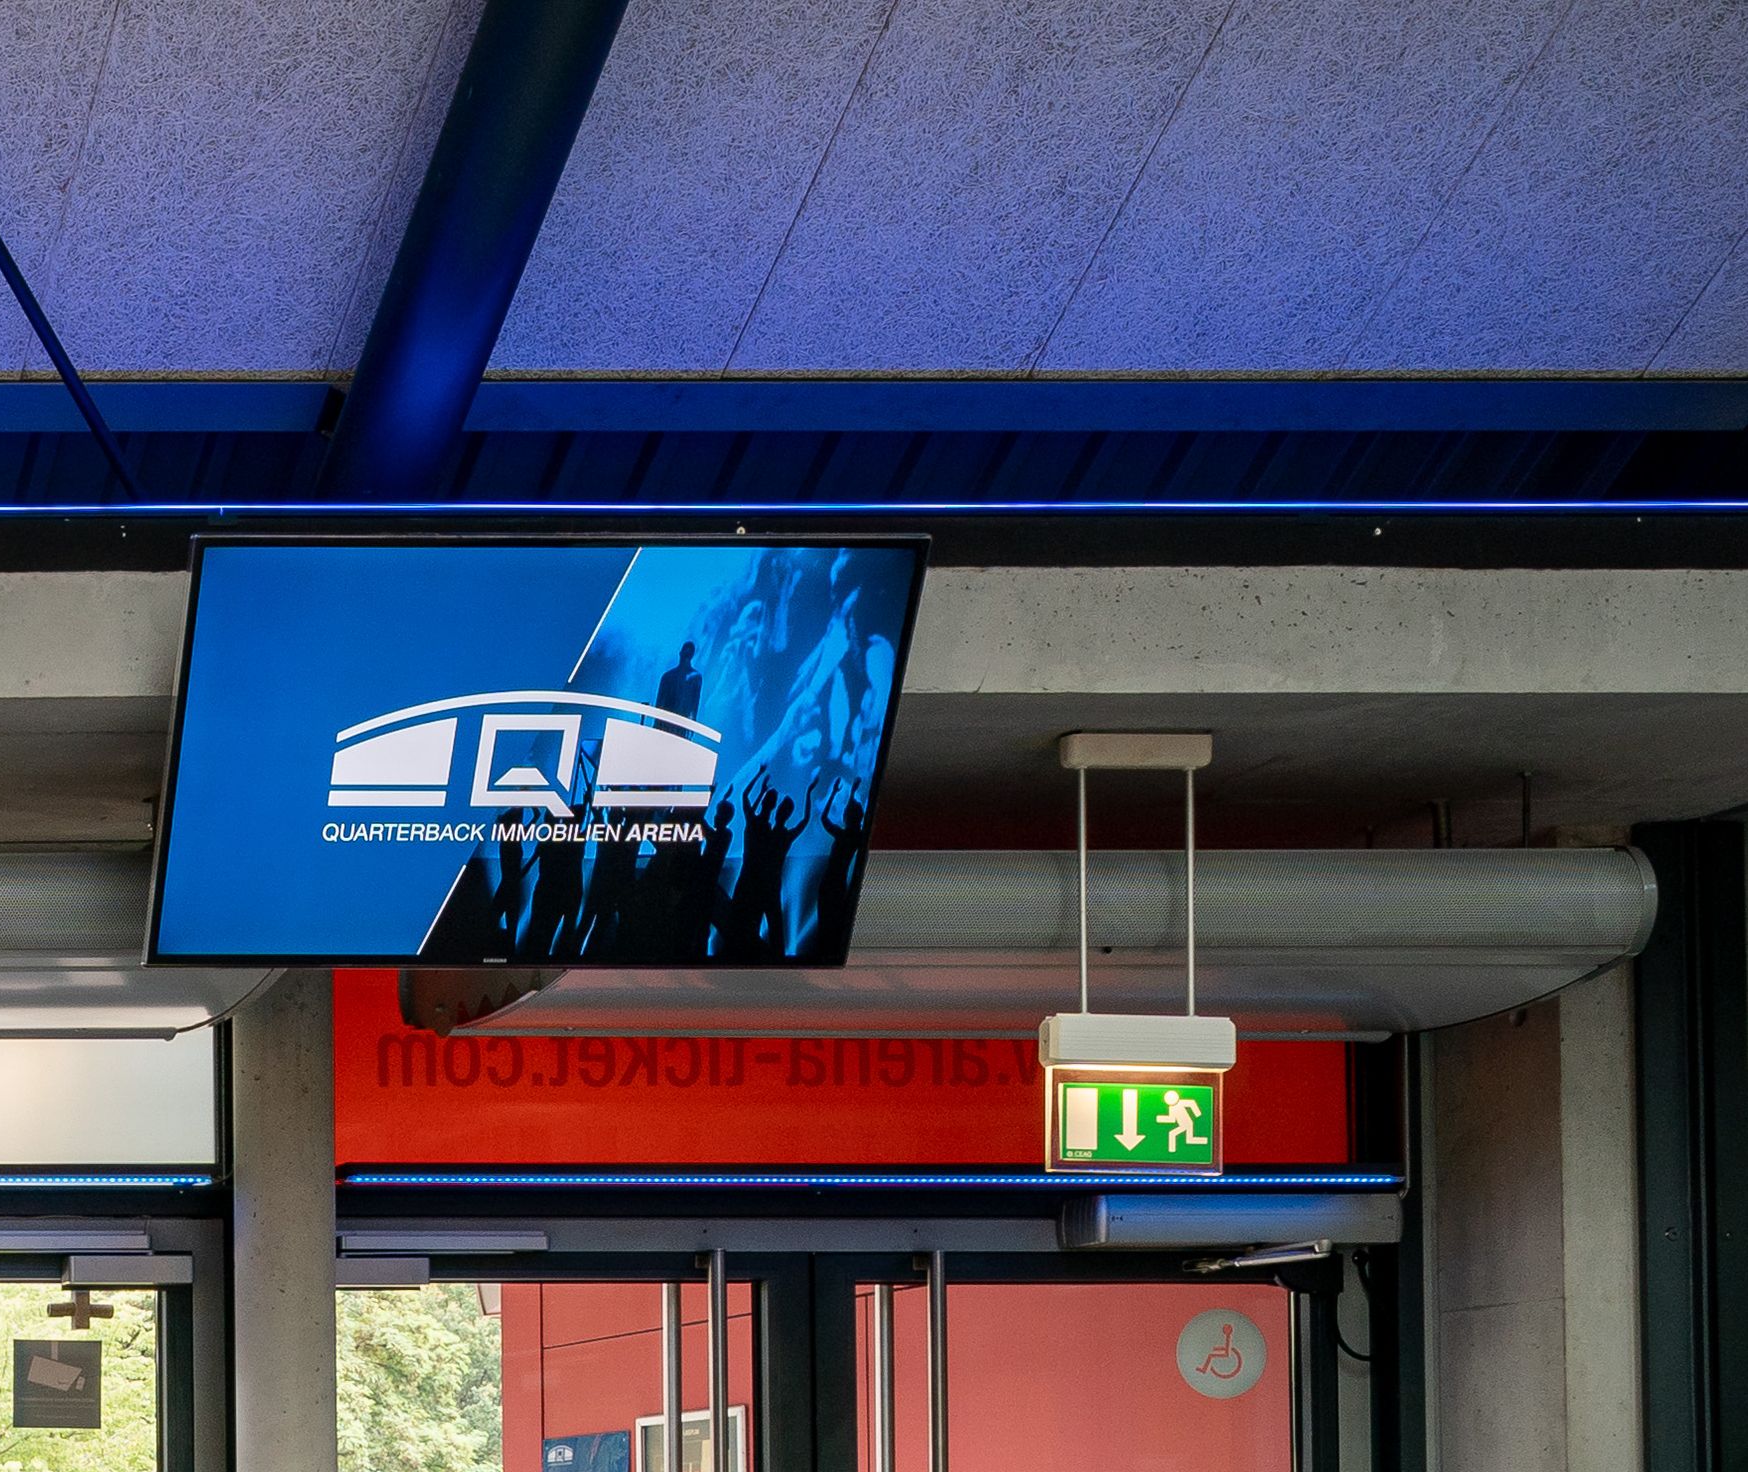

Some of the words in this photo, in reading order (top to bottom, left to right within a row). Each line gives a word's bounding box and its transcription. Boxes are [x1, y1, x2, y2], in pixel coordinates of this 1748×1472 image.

[321, 822, 485, 843] QUARTERBACK
[489, 822, 622, 843] IMMOBILIEN
[624, 823, 705, 843] ARENA
